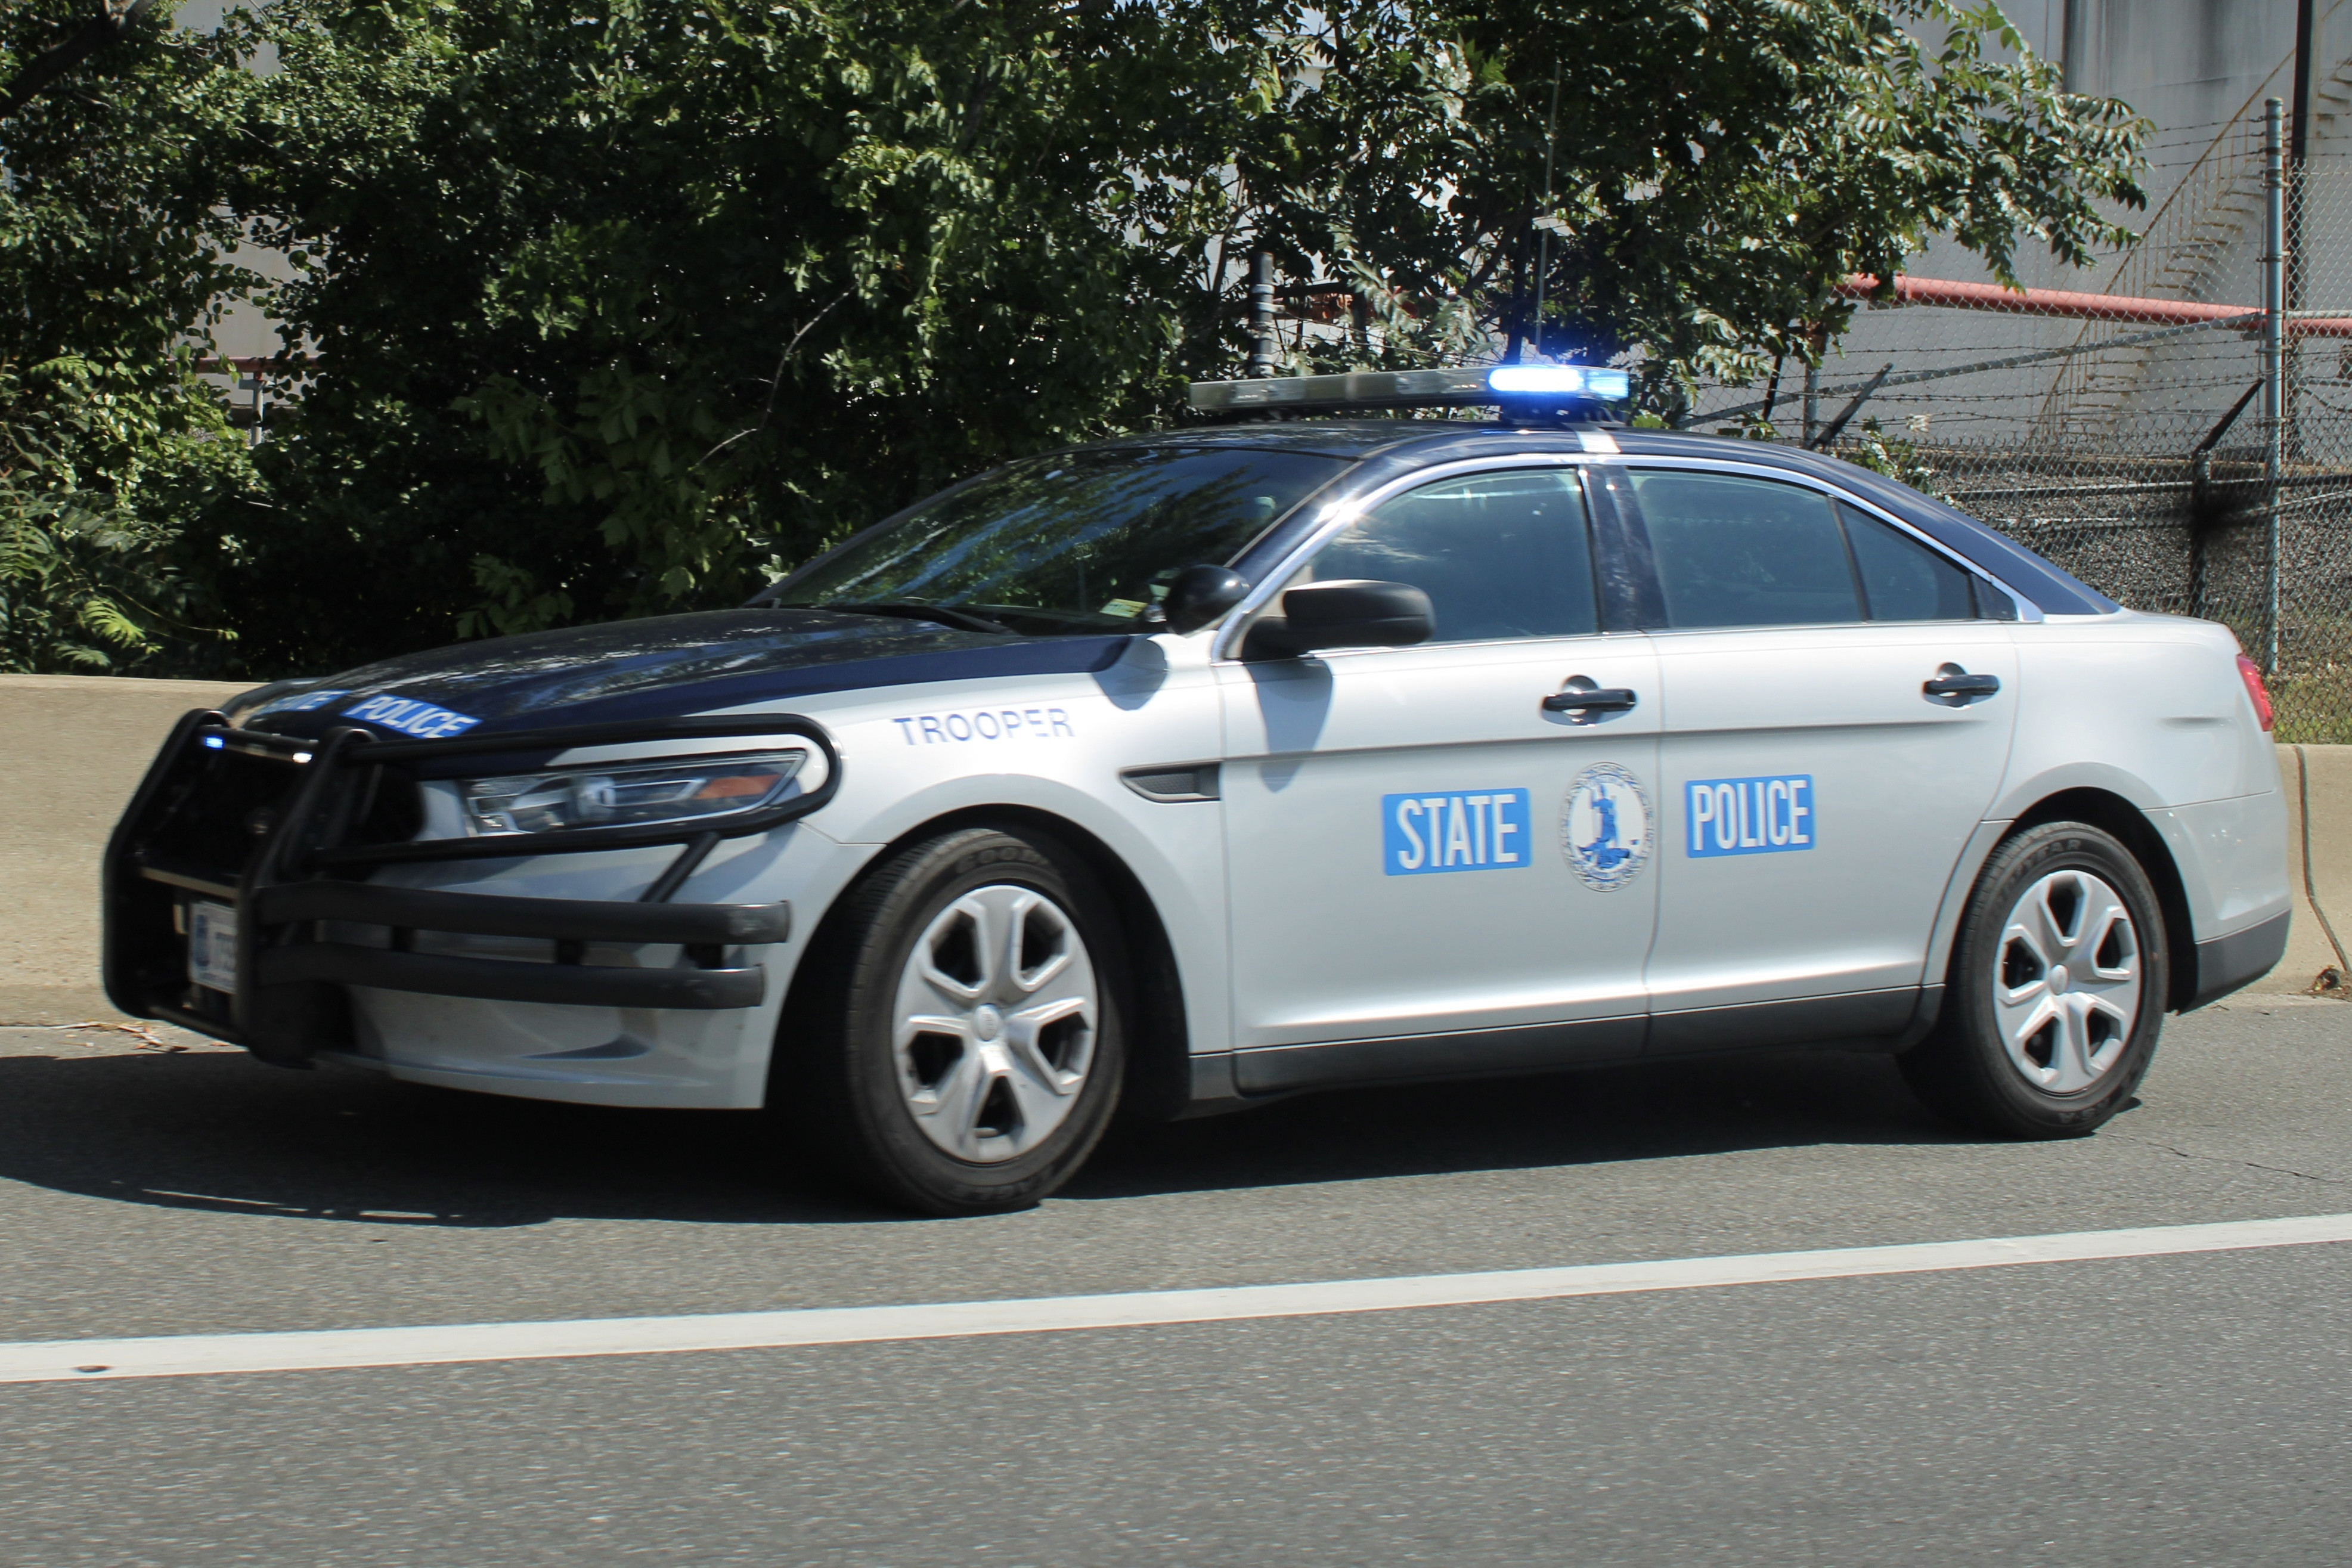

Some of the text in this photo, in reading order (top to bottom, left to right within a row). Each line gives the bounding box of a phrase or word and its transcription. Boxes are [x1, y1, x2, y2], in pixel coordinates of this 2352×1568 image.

[345, 696, 478, 739] POLICE
[892, 708, 1075, 745] TROOPER
[1396, 794, 1519, 870] STATE
[1690, 779, 1809, 851] POLICE
